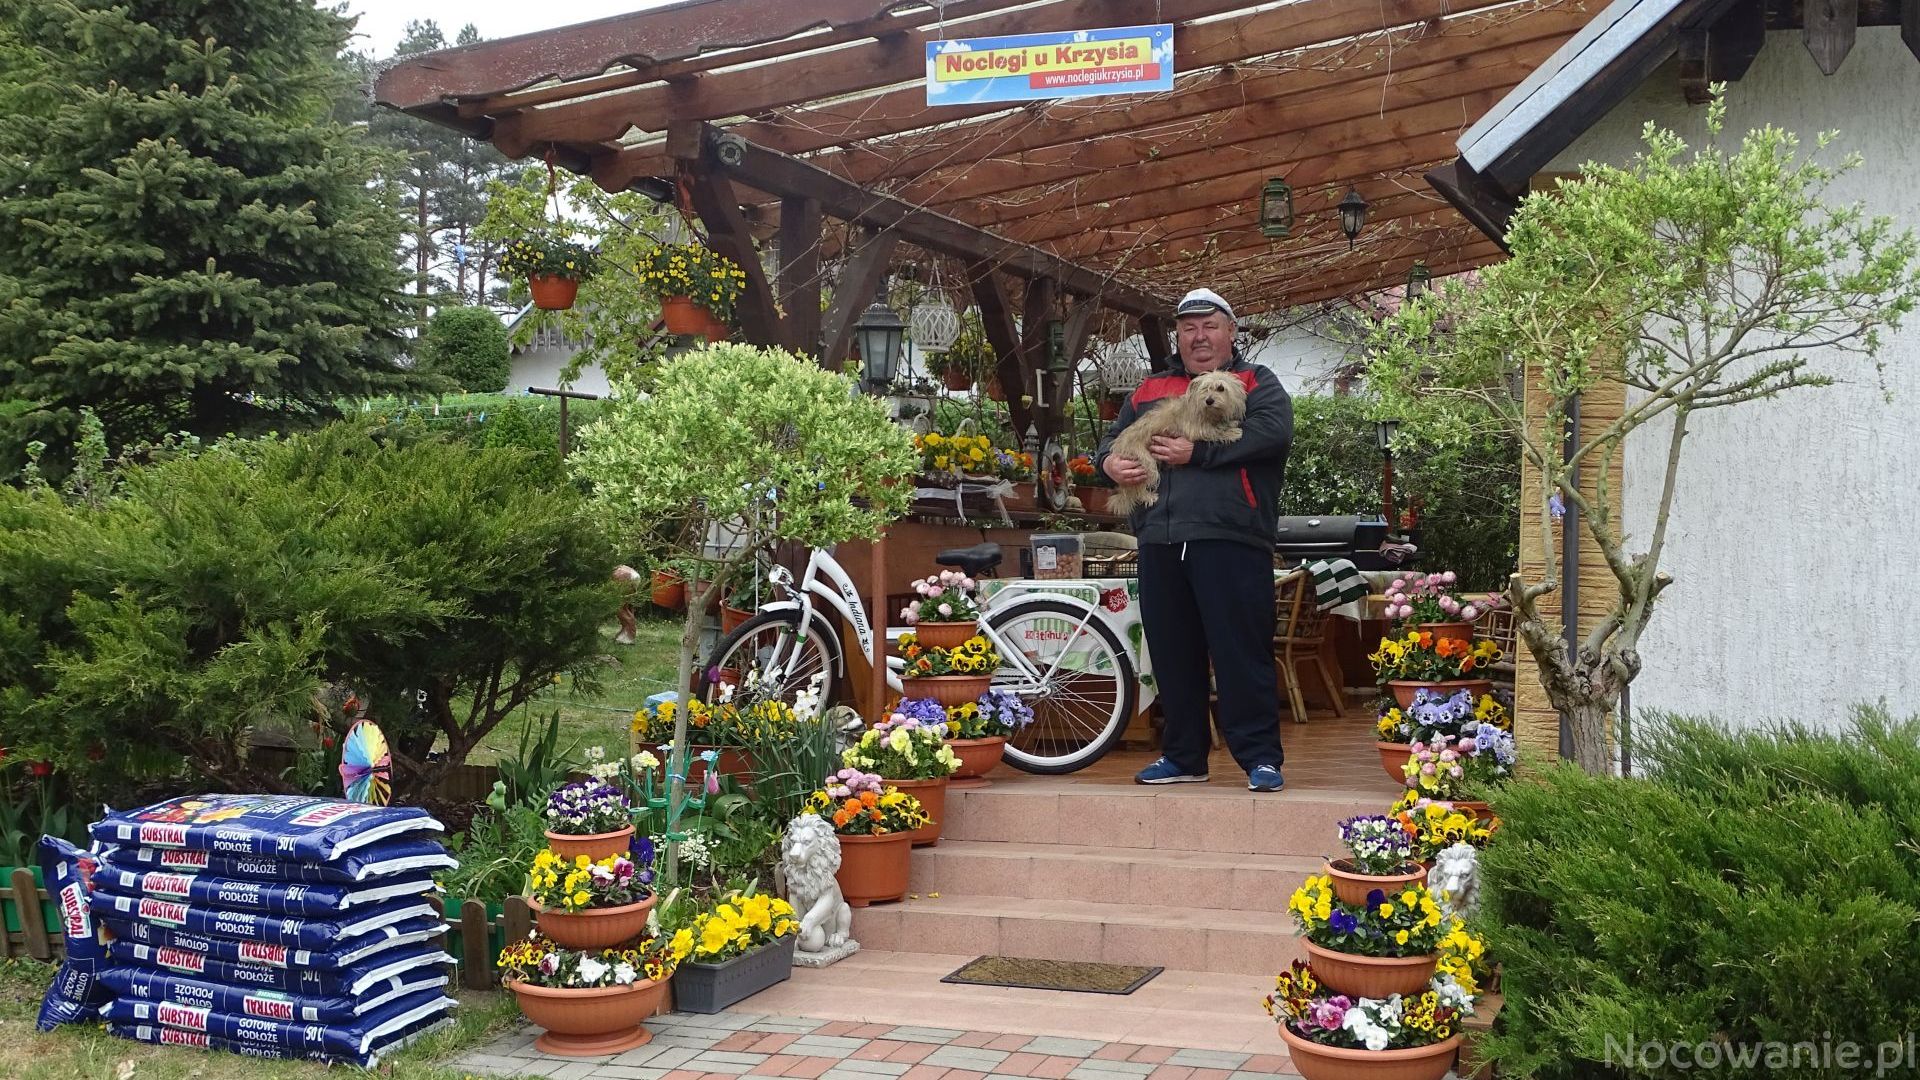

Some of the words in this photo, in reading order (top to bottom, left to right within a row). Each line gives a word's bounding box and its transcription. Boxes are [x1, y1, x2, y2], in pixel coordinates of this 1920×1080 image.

[946, 49, 1027, 73] Noclegi
[1035, 53, 1047, 66] u
[1056, 41, 1139, 66] Krzysia
[1045, 65, 1144, 85] www.noclegiukrzysia.pl
[848, 601, 866, 635] Indiana
[141, 826, 185, 844] SUBSTRAL
[216, 830, 253, 842] GOTOWE
[213, 840, 253, 853] PODŁOŻE
[163, 850, 207, 865] SUBSTRAL
[237, 862, 277, 874] PODŁOŻE
[144, 875, 190, 894] SUBSTRAL
[222, 881, 261, 892] GOTOWE
[219, 891, 259, 904] PODŁOŻE
[62, 888, 84, 937] SUBSTRAL
[140, 899, 185, 922] SUBSTRAL
[218, 911, 257, 924] GOTOWE
[215, 921, 255, 936] PODŁOŻE
[174, 936, 209, 951] GOTOWE
[241, 941, 287, 962] SUBSTRAL
[159, 947, 204, 969] SUBSTRAL
[234, 969, 275, 983] PODŁOŻE
[174, 983, 214, 999] PODŁOŻE
[245, 998, 292, 1020] SUBSTRAL
[160, 1006, 205, 1029] SUBSTRAL
[239, 1017, 279, 1032] GOTOWE
[162, 1027, 209, 1048] SUBSTRAL
[237, 1029, 278, 1043] PODŁOŻE
